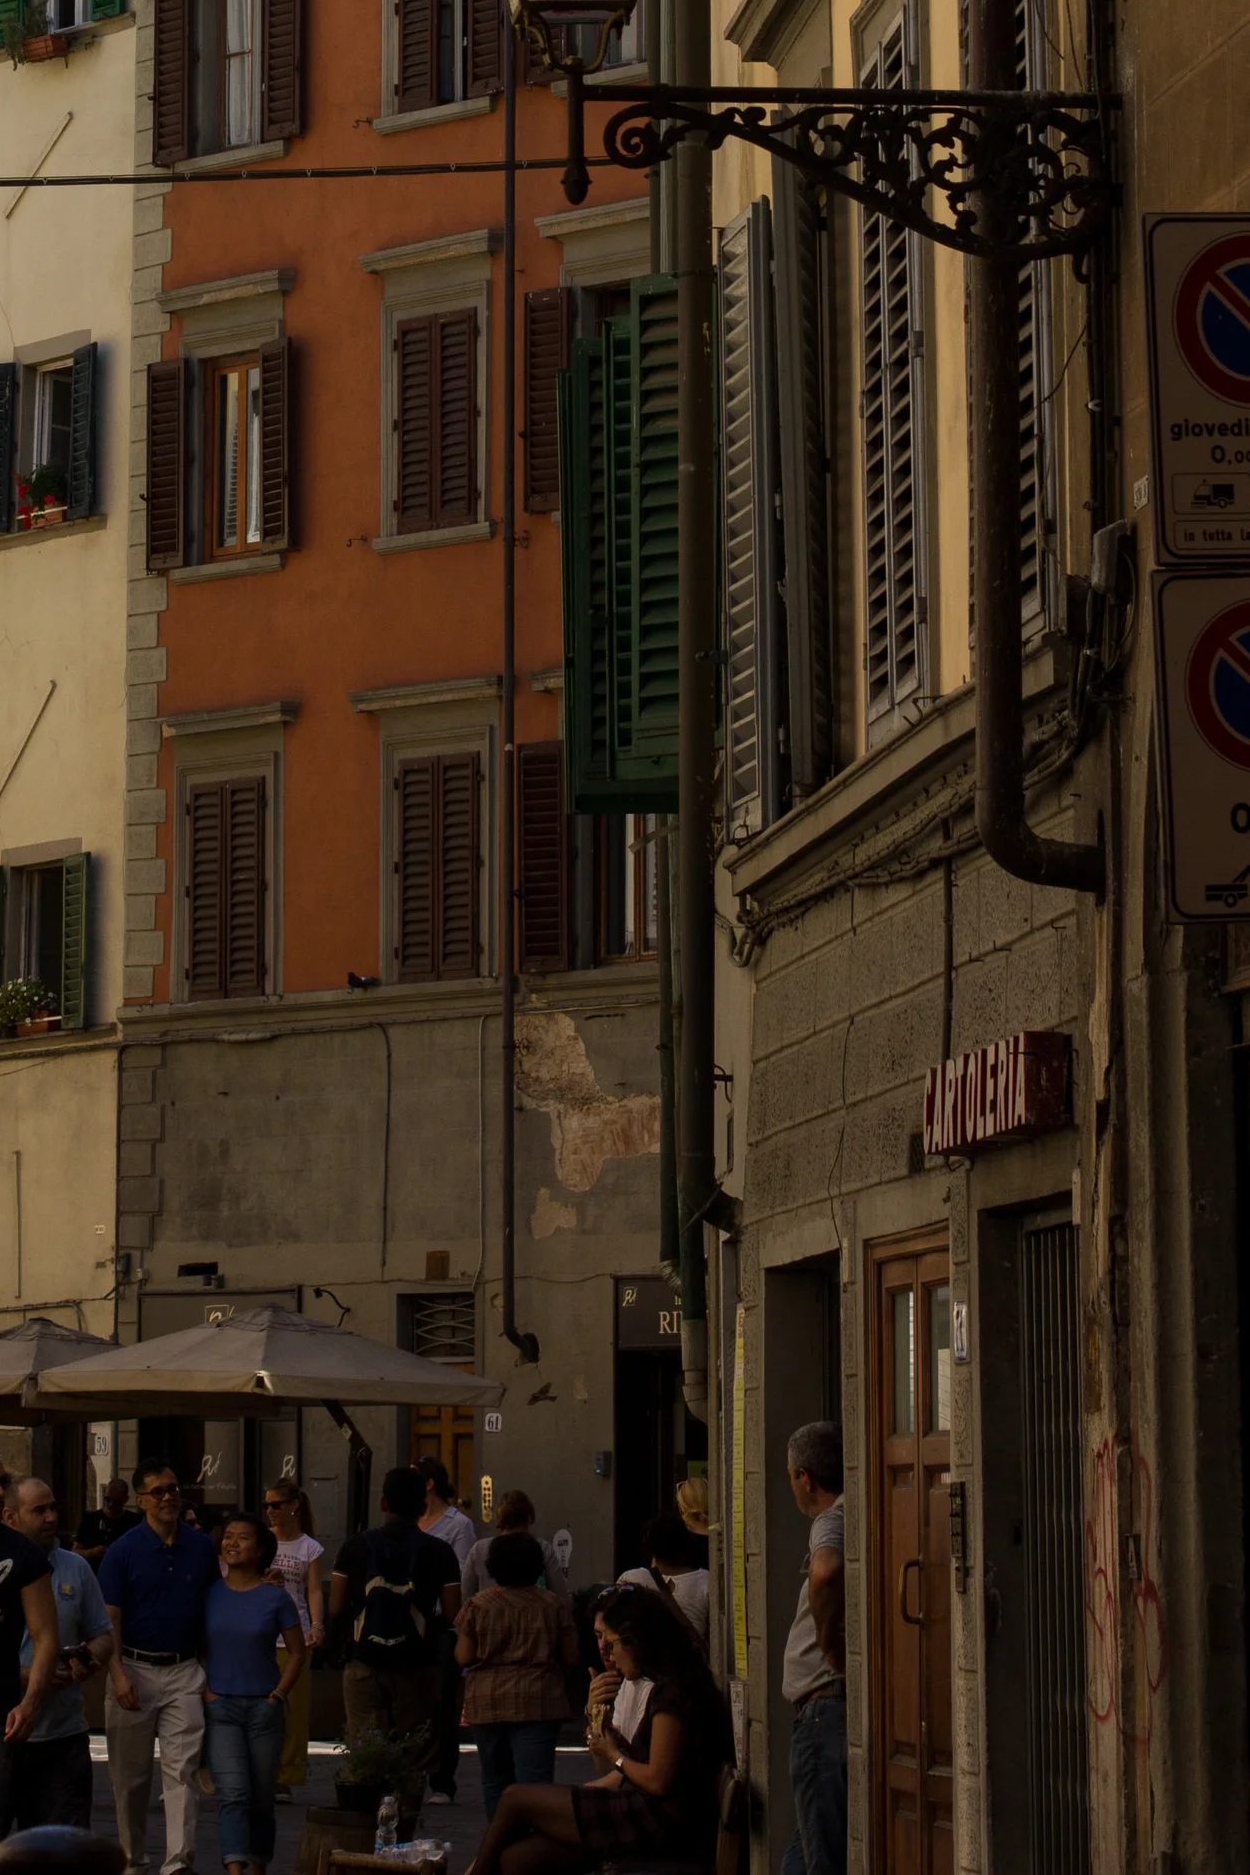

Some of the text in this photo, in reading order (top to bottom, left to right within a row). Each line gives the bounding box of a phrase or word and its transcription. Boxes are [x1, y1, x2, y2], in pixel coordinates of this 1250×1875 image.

[1184, 528, 1195, 542] in
[1203, 528, 1233, 542] tutta
[923, 1031, 1026, 1155] CARTOLERIA
[487, 1415, 500, 1431] 61
[96, 1436, 108, 1454] 59
